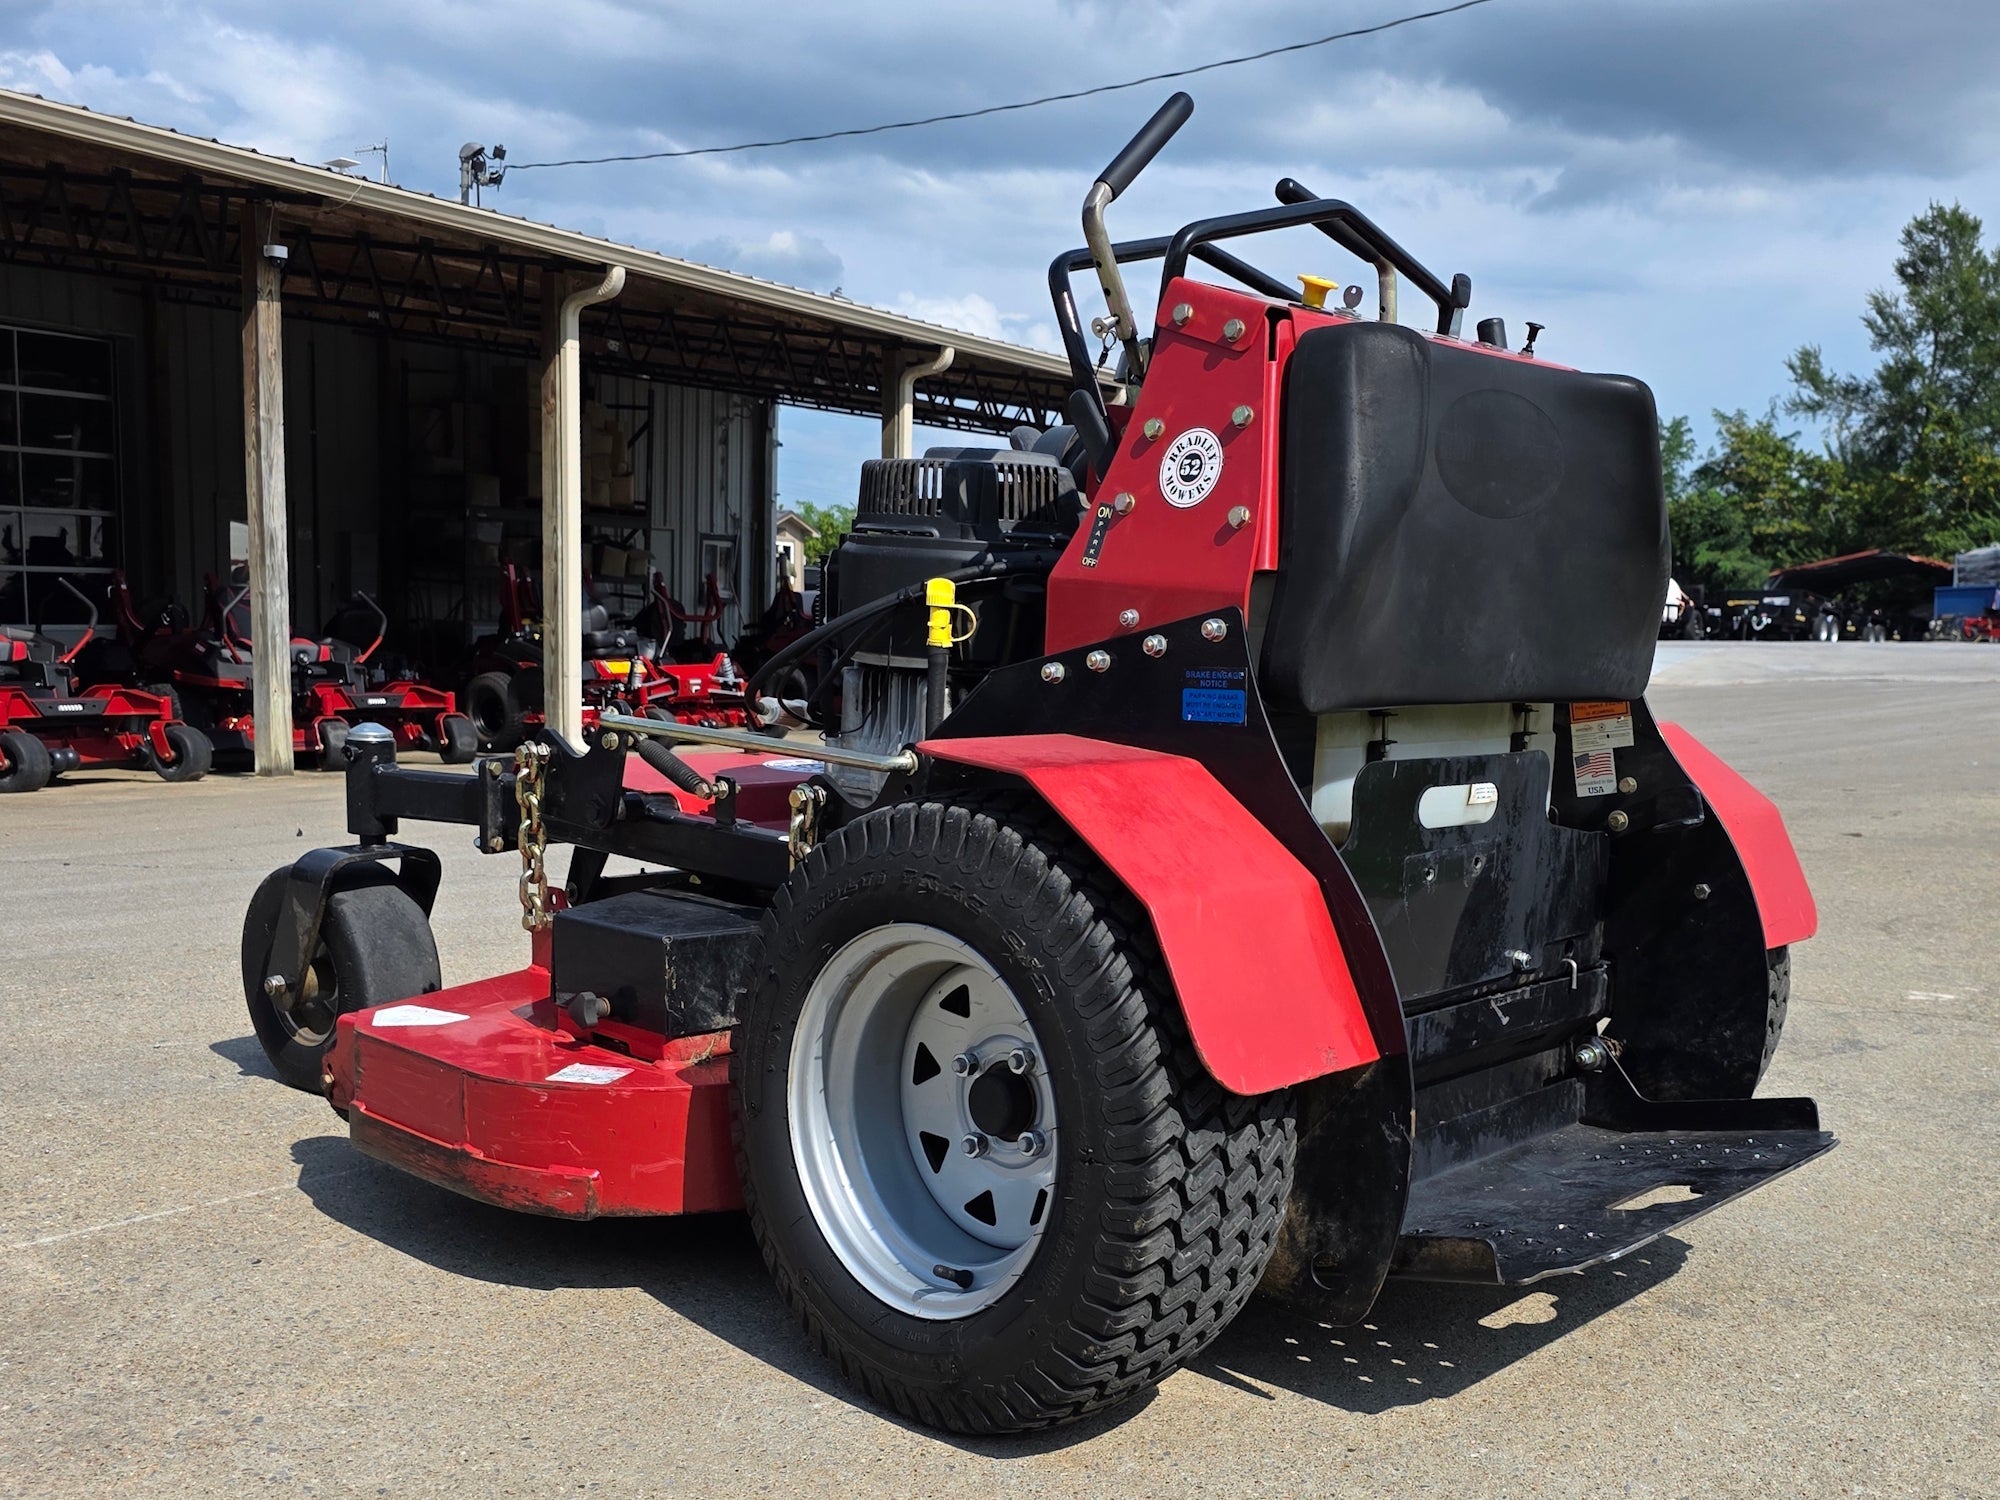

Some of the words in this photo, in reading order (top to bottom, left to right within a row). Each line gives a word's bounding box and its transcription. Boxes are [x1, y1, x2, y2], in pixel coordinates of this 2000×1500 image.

[1169, 435, 1217, 463] BRADLEY
[1181, 459, 1201, 476] 52
[1166, 475, 1211, 500] MOWERS
[1097, 506, 1113, 519] ON
[1081, 556, 1098, 567] OFF
[1185, 670, 1210, 679] BRAKE
[1200, 680, 1228, 688] NOTICE
[1587, 786, 1605, 794] USA
